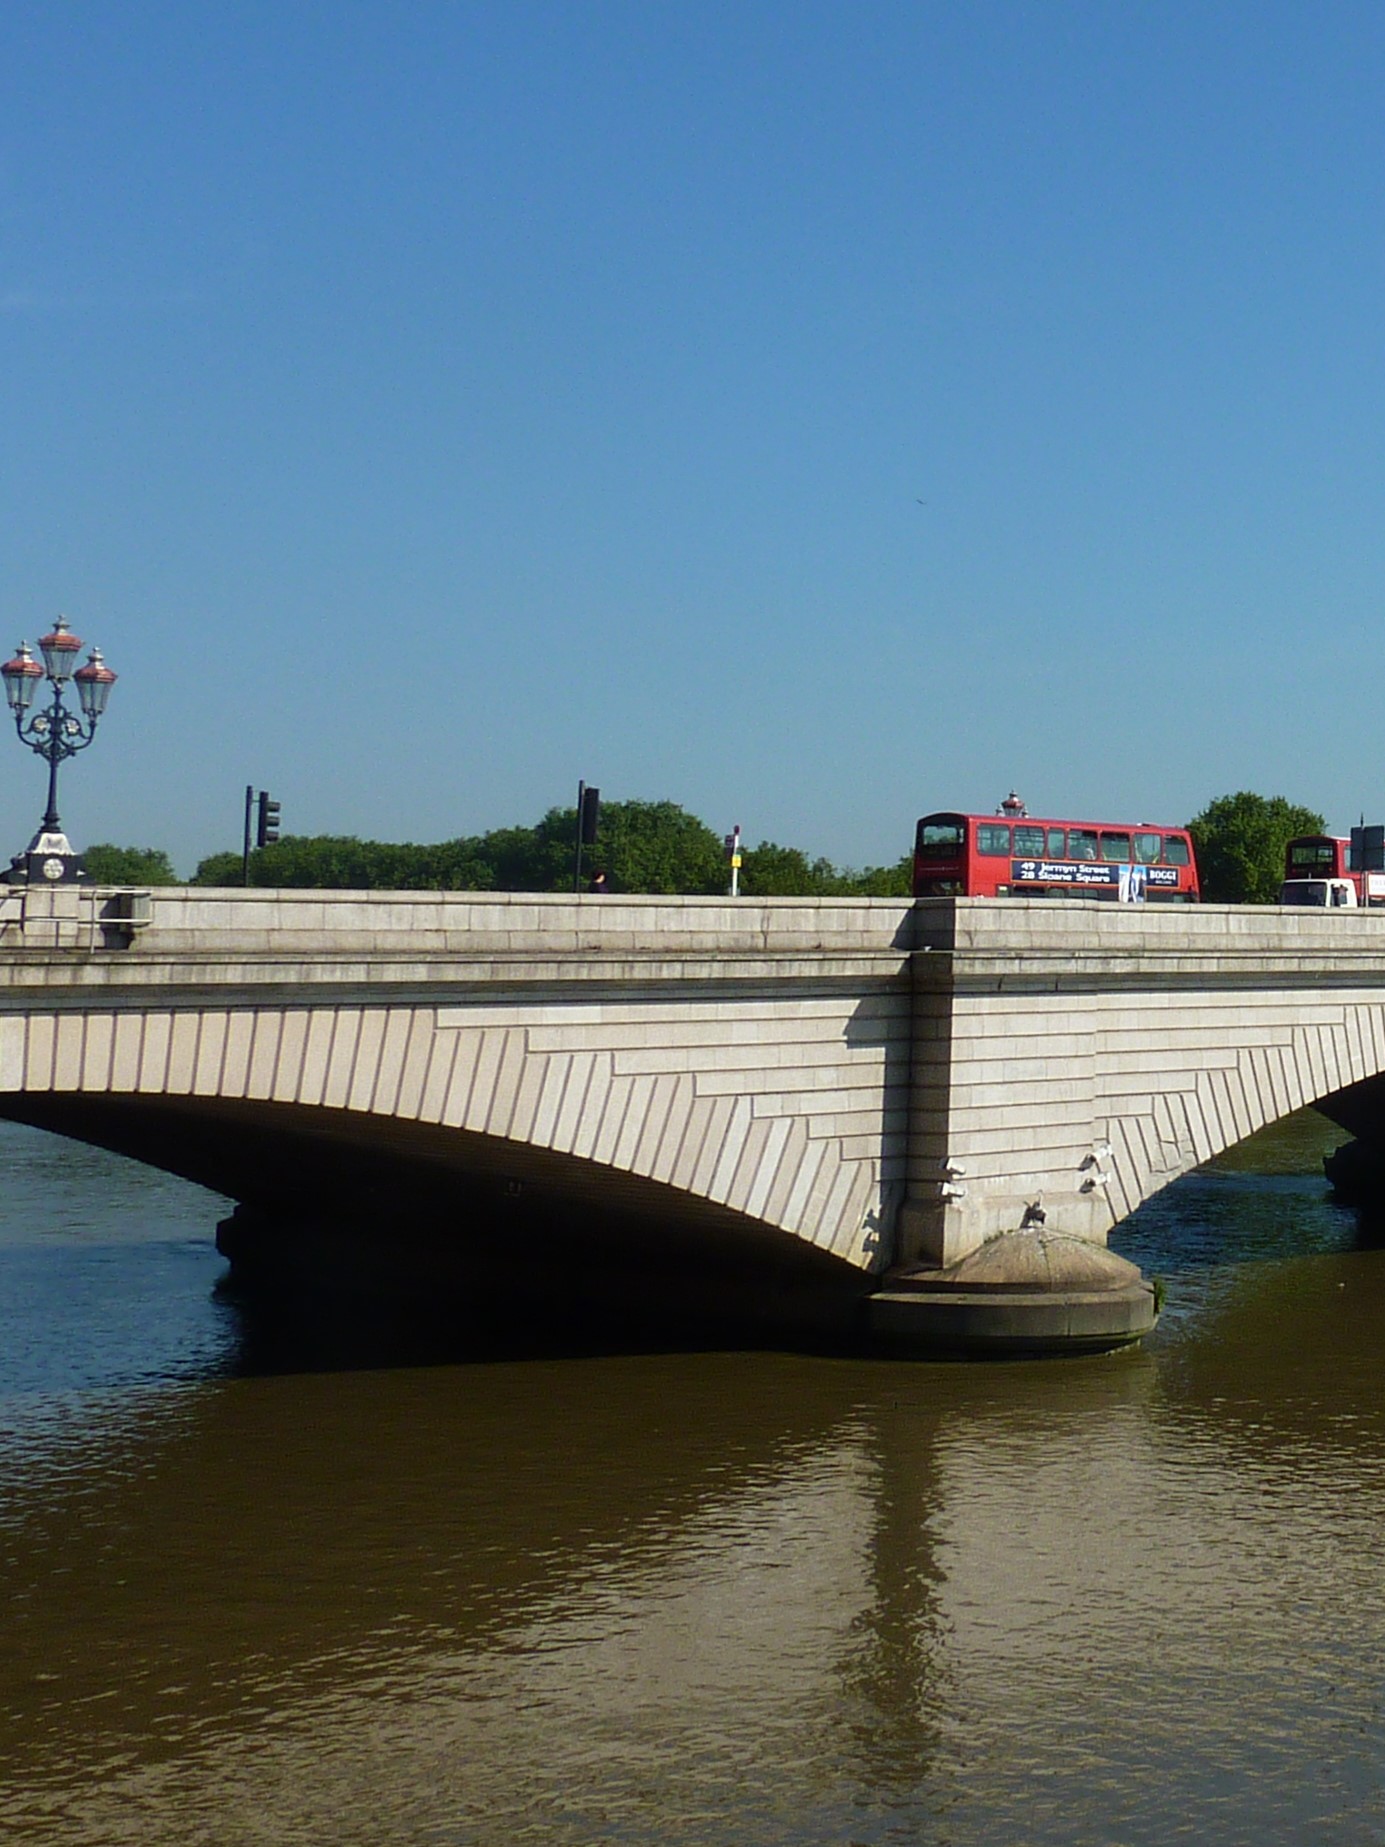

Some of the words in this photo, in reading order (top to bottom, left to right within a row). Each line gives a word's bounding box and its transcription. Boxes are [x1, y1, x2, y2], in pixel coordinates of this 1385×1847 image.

[1021, 862, 1035, 870] 49
[1040, 863, 1077, 874] Jermyn
[1079, 865, 1110, 874] Street
[1038, 872, 1072, 881] Sloane
[1076, 873, 1110, 883] Square
[1149, 870, 1176, 880] BOGGI
